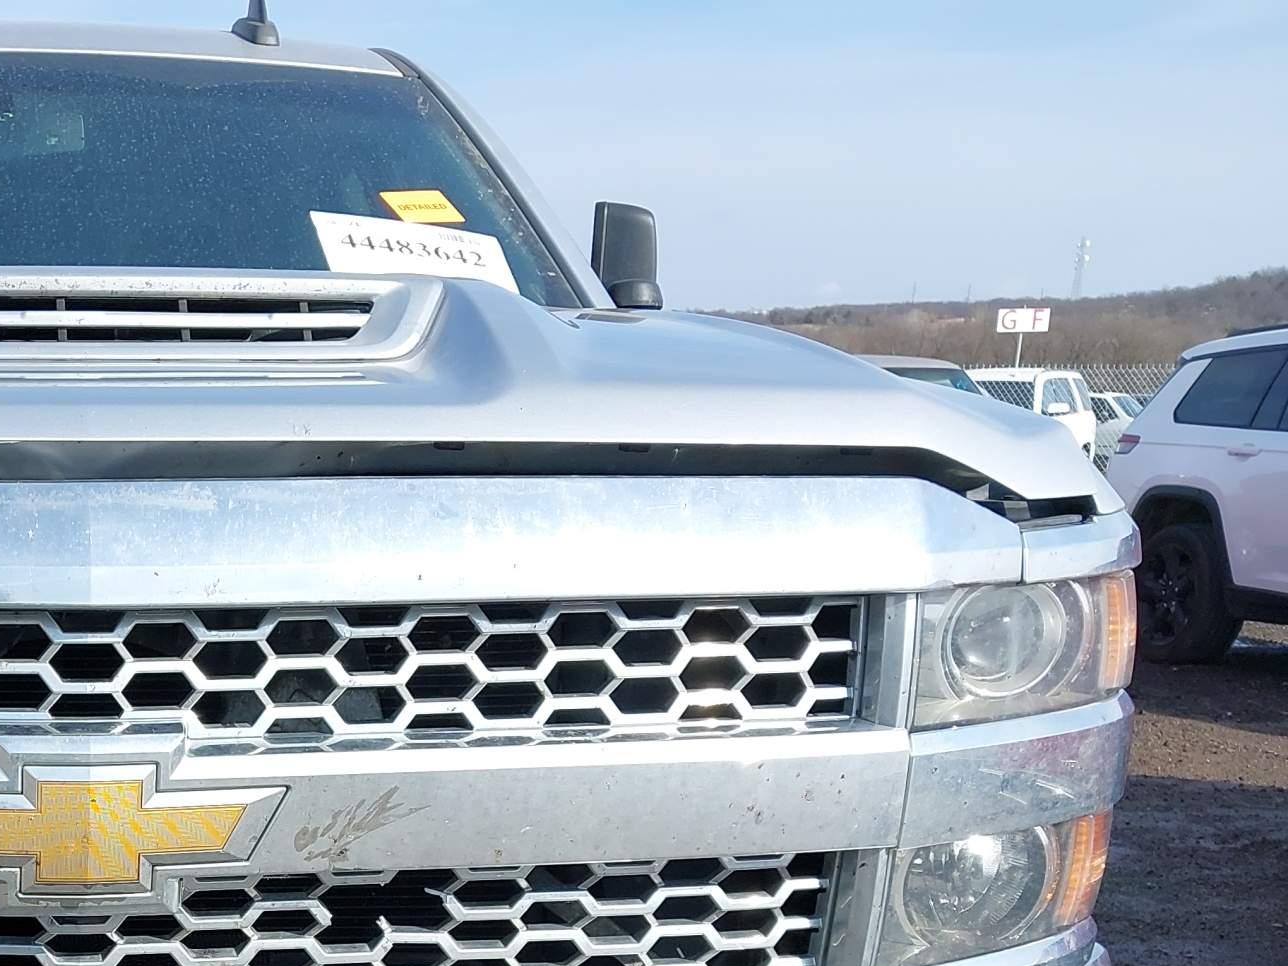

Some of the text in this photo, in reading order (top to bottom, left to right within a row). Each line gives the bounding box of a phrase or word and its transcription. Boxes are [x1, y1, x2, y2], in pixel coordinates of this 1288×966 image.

[397, 203, 448, 212] DETAILED
[339, 232, 488, 268] 44483642
[1001, 308, 1045, 331] G F
